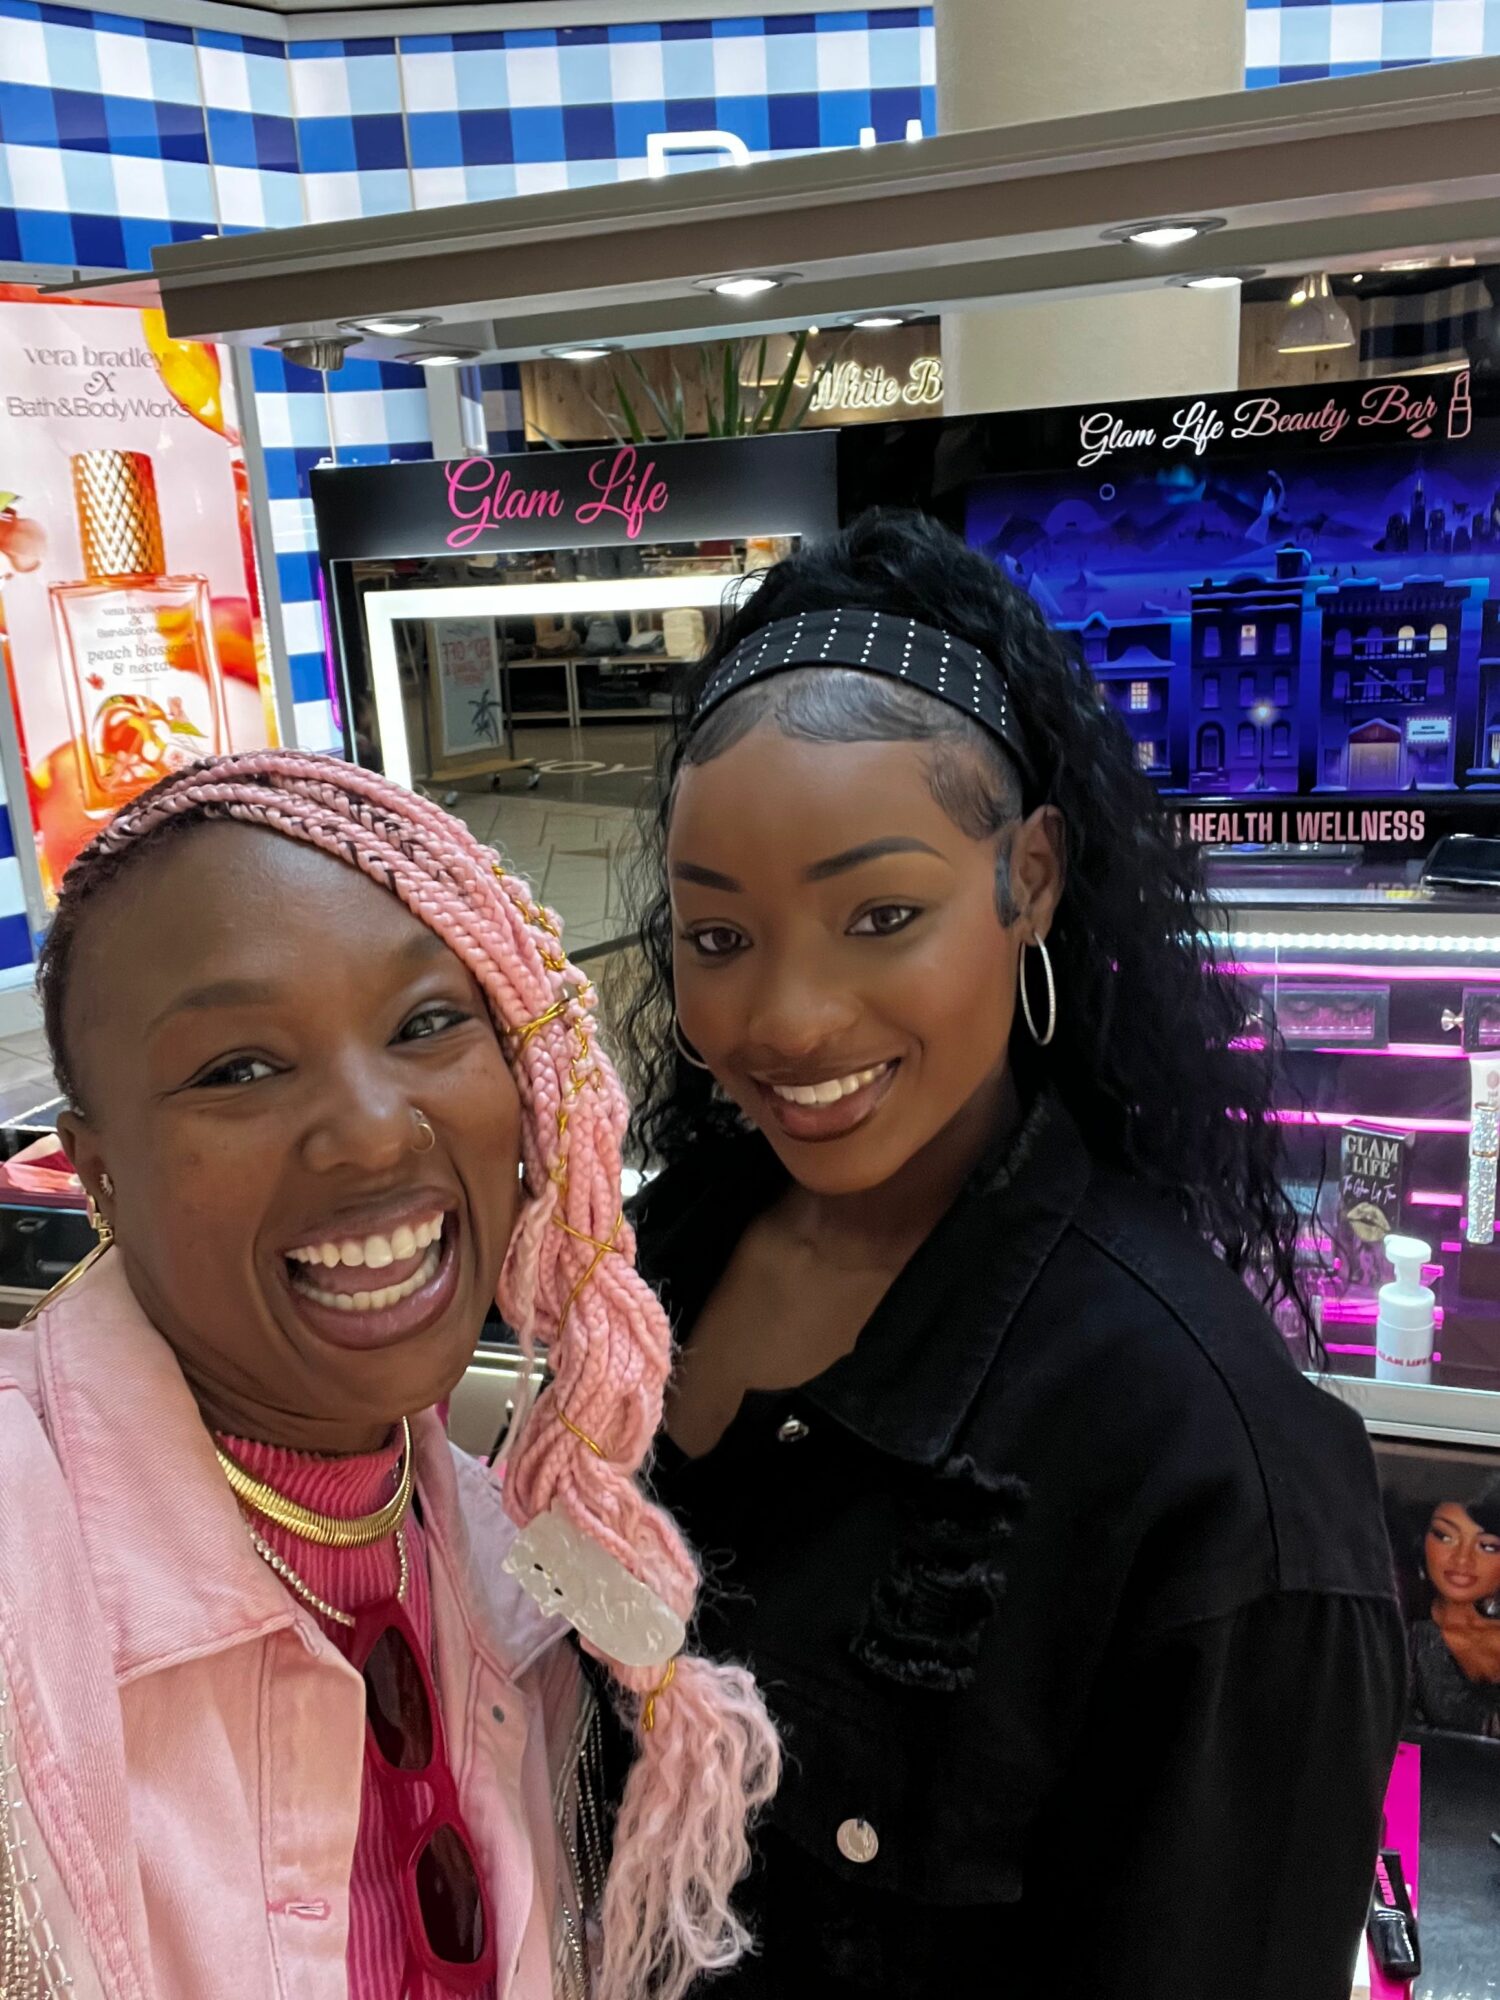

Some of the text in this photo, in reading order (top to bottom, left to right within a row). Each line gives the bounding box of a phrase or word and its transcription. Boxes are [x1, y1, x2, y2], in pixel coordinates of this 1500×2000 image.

[23, 347, 78, 366] vera
[809, 360, 901, 412] White
[1077, 384, 1438, 467] Glam Life Beauty Bar
[445, 444, 669, 548] Glam Life
[87, 645, 132, 665] peach
[1188, 812, 1273, 842] HEALTH
[1297, 810, 1425, 842] WELLNESS
[1345, 1134, 1399, 1164] GLAM
[1352, 1155, 1391, 1179] LIFE
